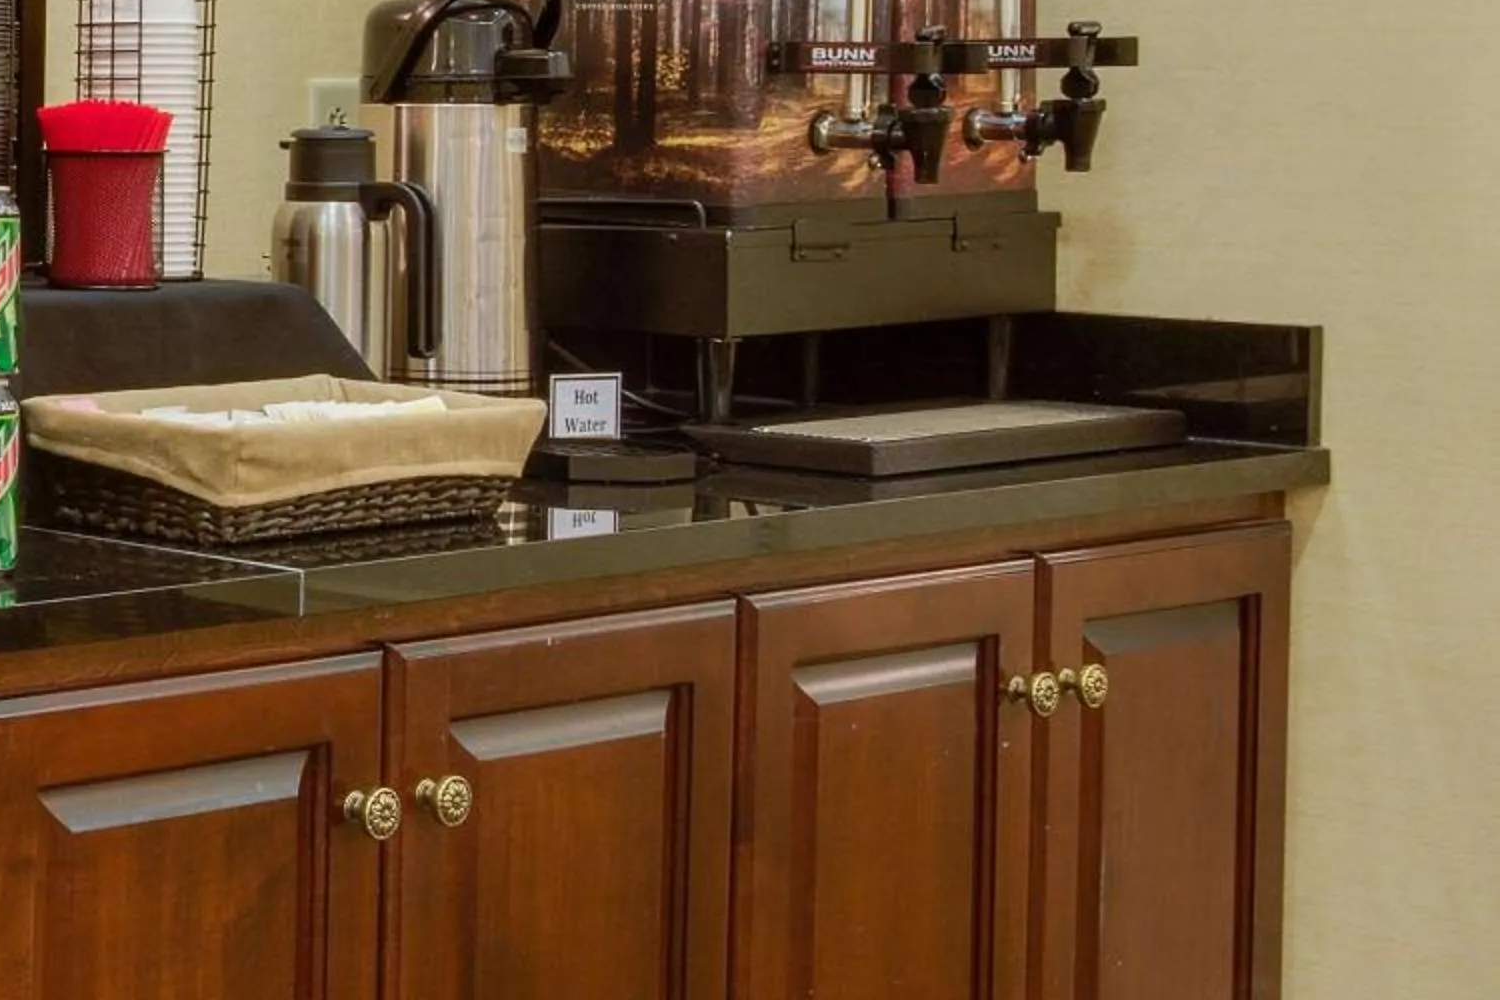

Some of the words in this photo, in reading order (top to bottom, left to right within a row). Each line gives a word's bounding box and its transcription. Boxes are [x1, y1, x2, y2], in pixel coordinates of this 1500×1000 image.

[811, 47, 875, 60] BUNN
[988, 45, 1035, 57] UNN
[574, 389, 599, 405] Hot
[565, 417, 608, 433] Water
